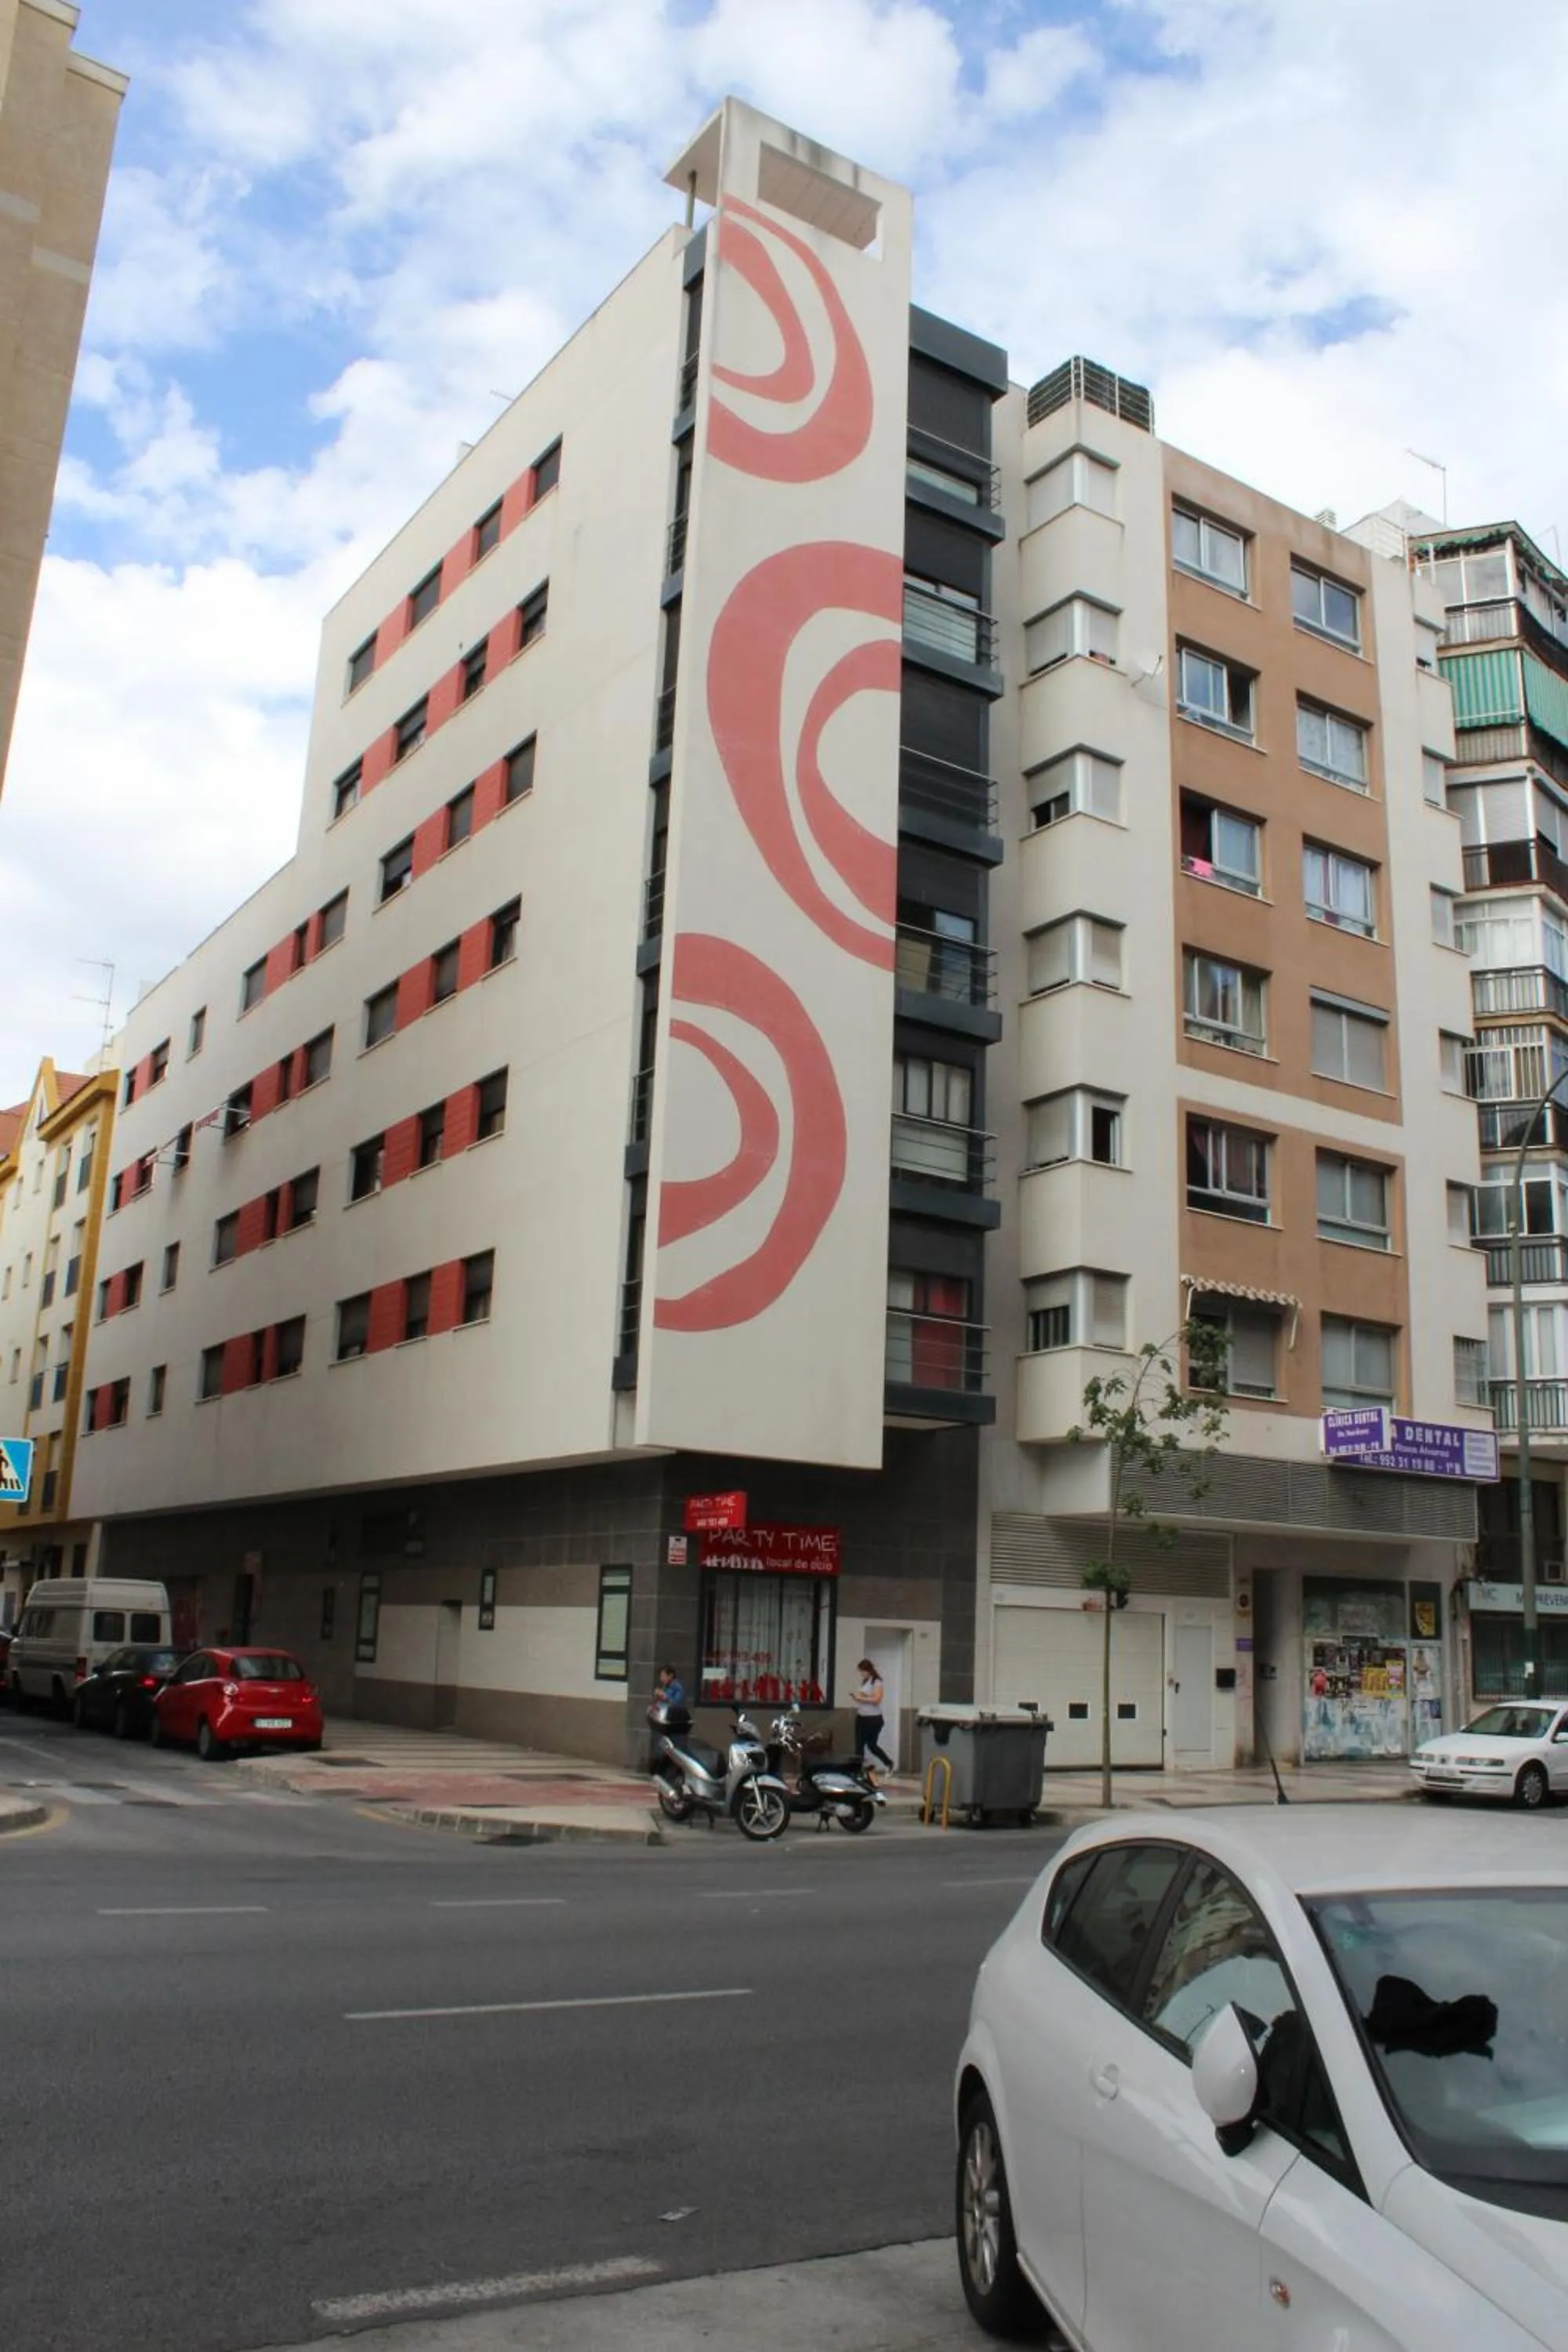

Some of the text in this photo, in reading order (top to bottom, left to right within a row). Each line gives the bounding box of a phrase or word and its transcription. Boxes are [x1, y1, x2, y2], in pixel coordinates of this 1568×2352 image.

[1354, 1410, 1378, 1425] DENTAL
[1405, 1425, 1460, 1447] DENTAL
[766, 1556, 833, 1570] local de ocio
